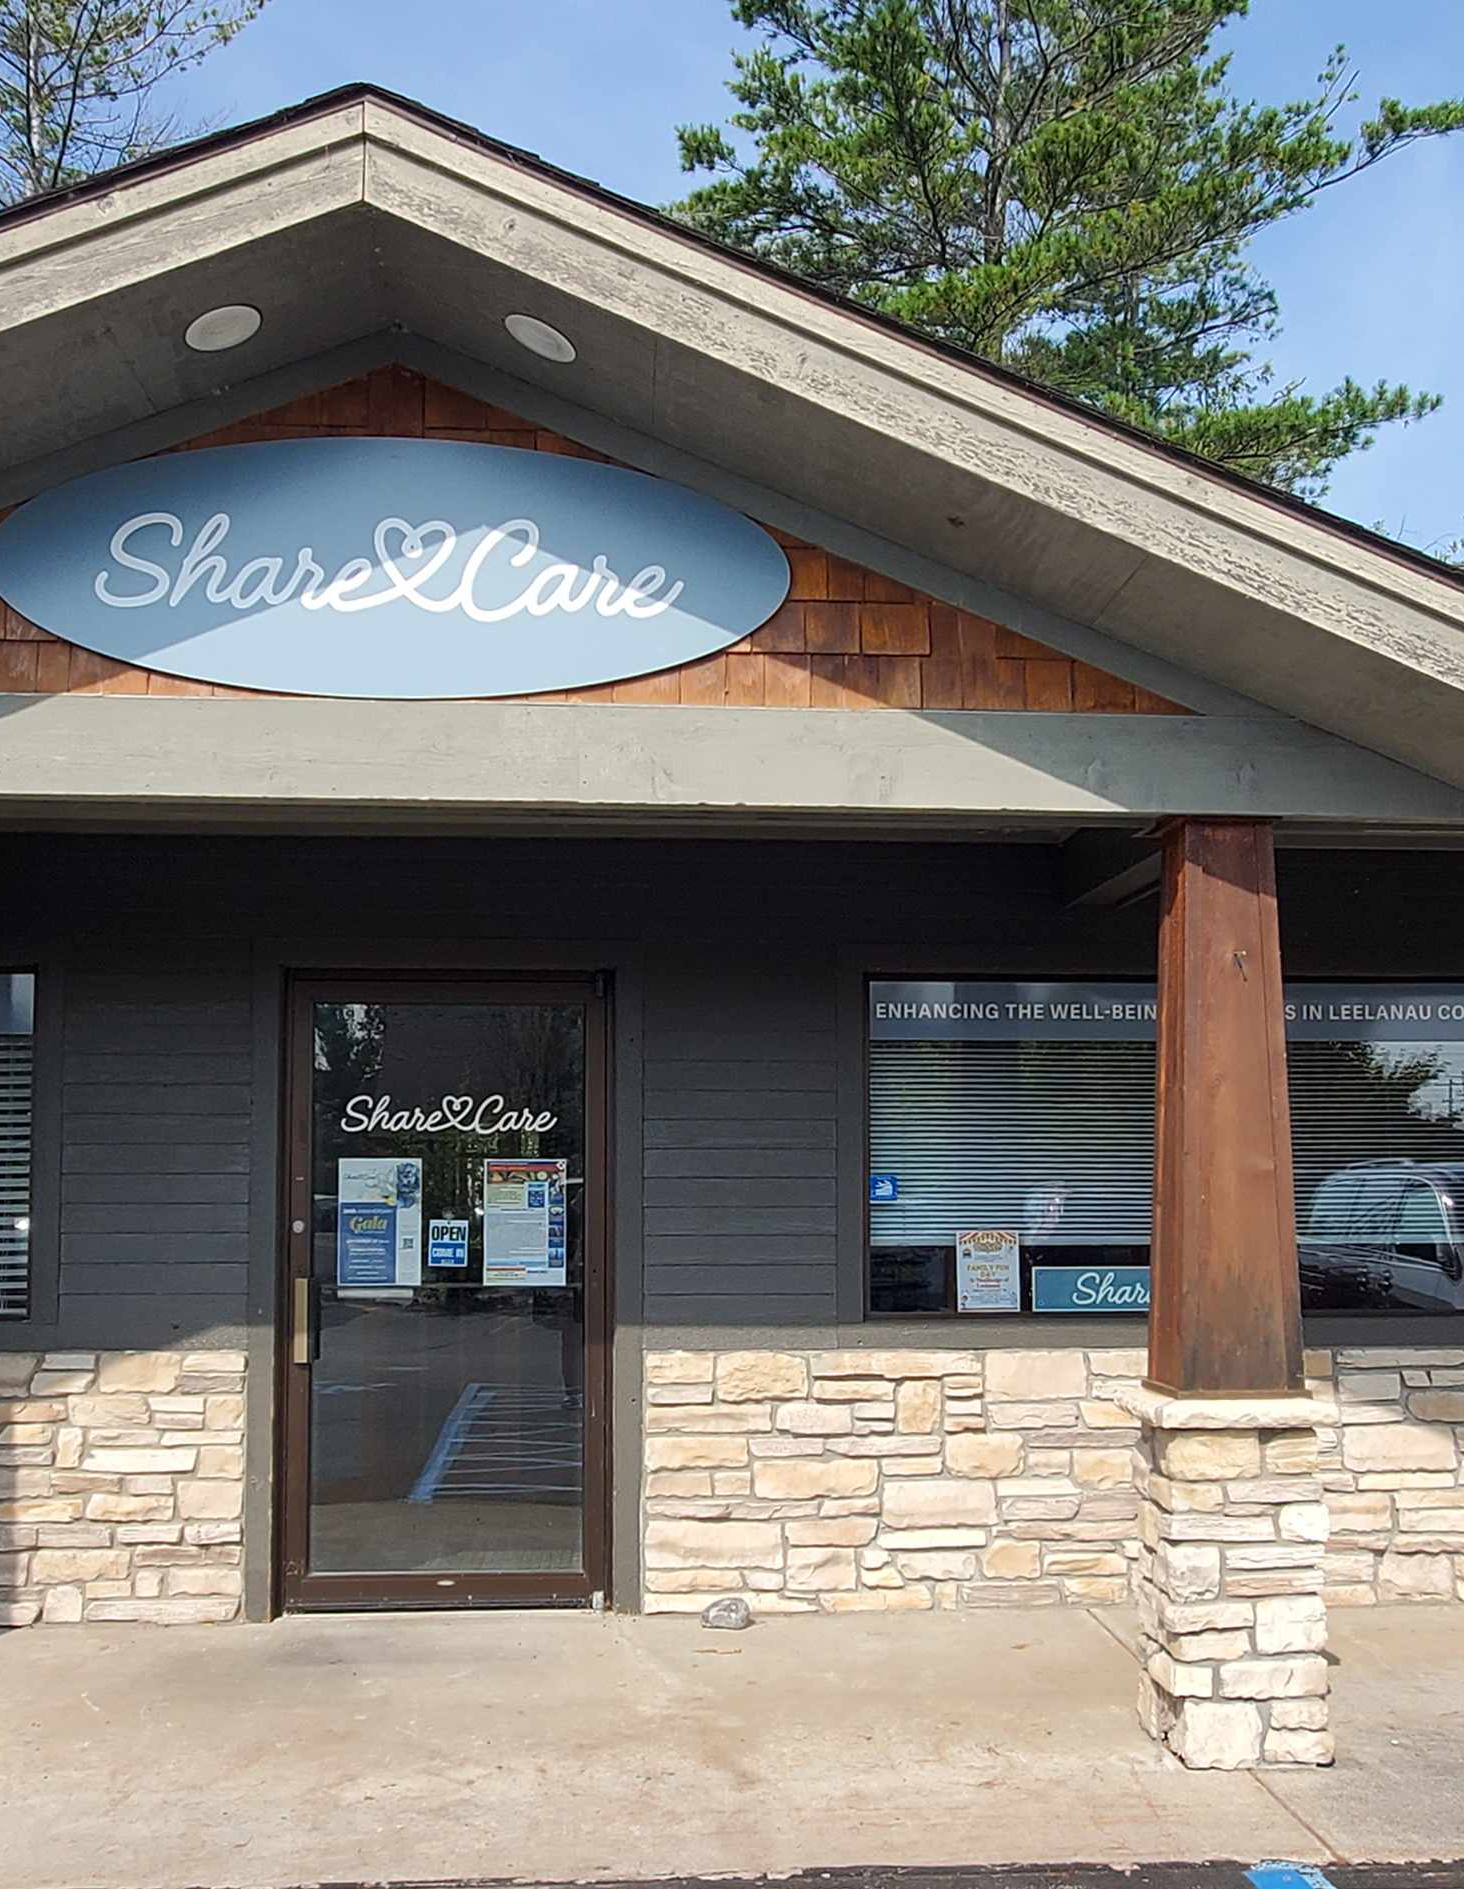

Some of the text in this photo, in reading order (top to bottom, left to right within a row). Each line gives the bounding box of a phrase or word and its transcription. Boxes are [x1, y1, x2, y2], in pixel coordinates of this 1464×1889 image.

[94, 511, 685, 623] Share Care
[875, 1003, 1158, 1021] ENHANCING THE WELL-BEIN
[1302, 1003, 1323, 1021] IN
[1328, 1003, 1432, 1021] LEELANAU
[340, 1094, 558, 1134] Share Care
[348, 1216, 388, 1234] Gala
[431, 1225, 466, 1241] OPEN
[1072, 1272, 1151, 1305] Shar
